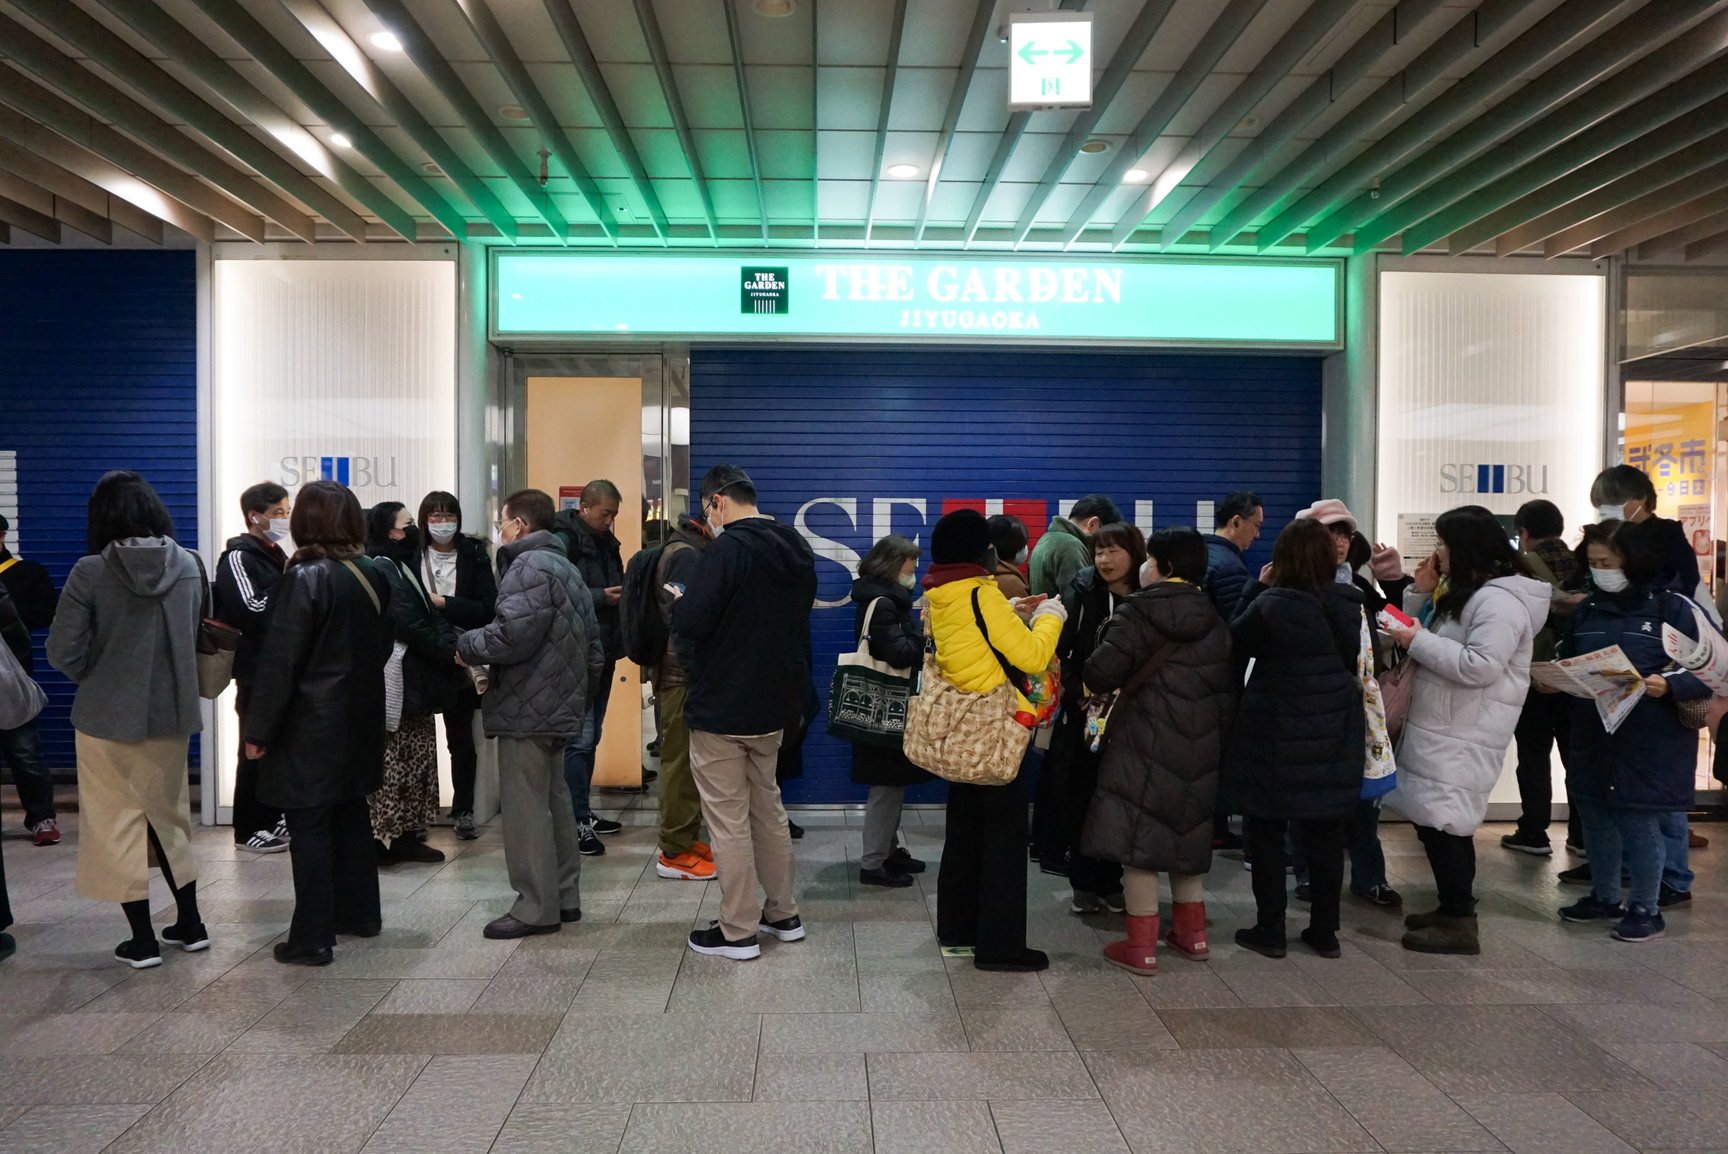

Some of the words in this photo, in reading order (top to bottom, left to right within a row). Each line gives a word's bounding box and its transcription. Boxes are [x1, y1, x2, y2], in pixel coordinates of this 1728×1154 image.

[754, 272, 776, 282] THE
[815, 264, 914, 301] THE
[927, 265, 1124, 304] GARDEN
[744, 281, 785, 290] GARDEN
[900, 309, 1040, 330] JIYUGAOKA
